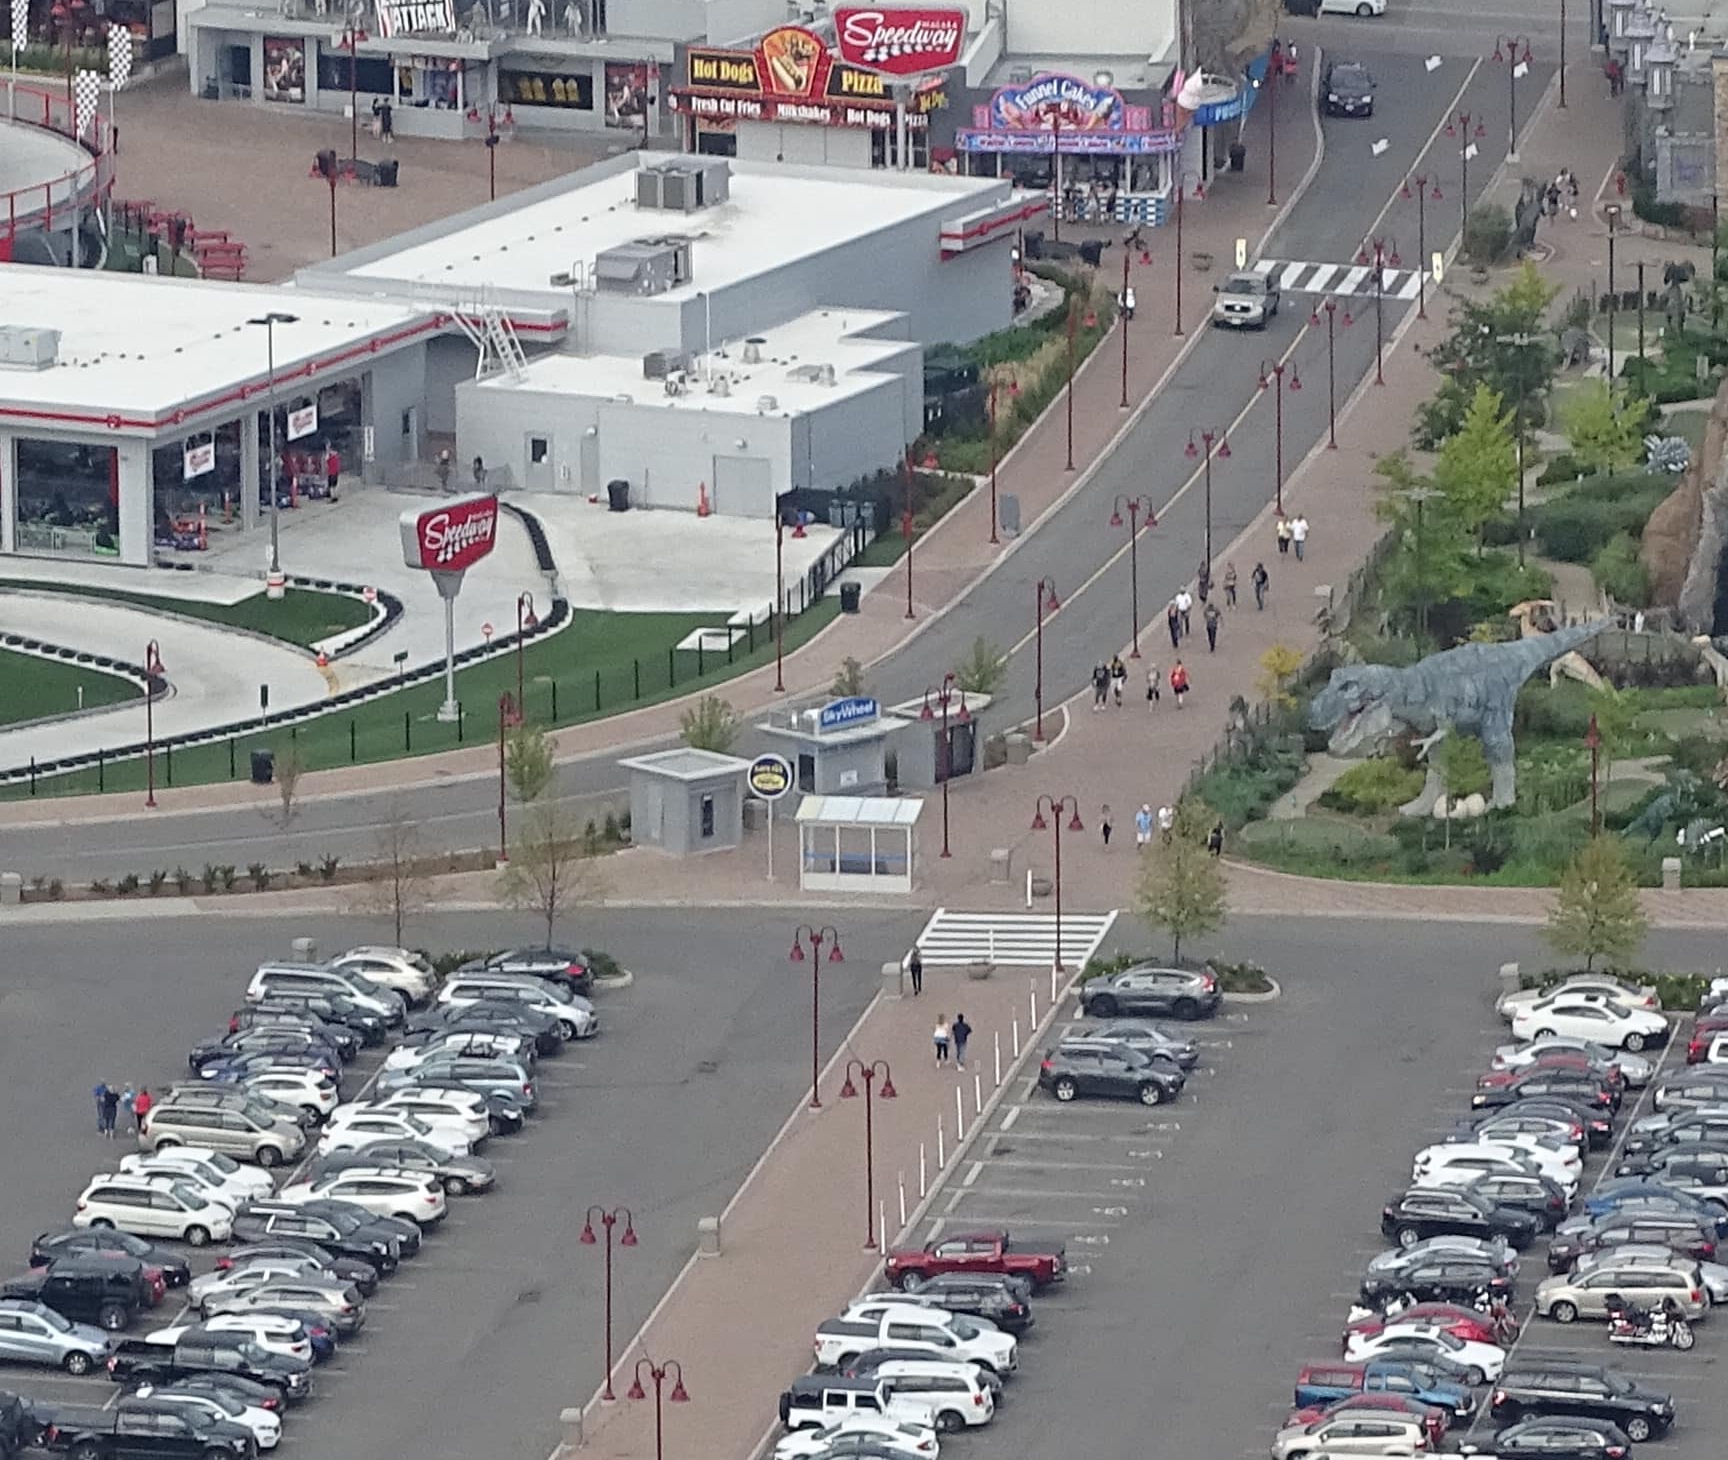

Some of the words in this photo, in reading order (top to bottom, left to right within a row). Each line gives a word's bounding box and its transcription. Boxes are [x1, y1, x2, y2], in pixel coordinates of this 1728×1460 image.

[390, 4, 450, 35] ATTACK
[842, 11, 960, 54] Speedway
[692, 58, 719, 81] Hot
[720, 59, 755, 85] Dogs
[841, 70, 884, 96] Pizza
[691, 96, 718, 112] Fresh
[719, 98, 735, 114] Cut
[736, 99, 762, 117] Fries
[1014, 79, 1059, 111] Funnel
[1060, 79, 1098, 110] Cakes
[776, 102, 832, 122] Milkshakes
[846, 108, 864, 123] Hot
[865, 110, 891, 127] Dogs
[424, 512, 495, 551] Speedway
[822, 700, 875, 725] SkyWheel
